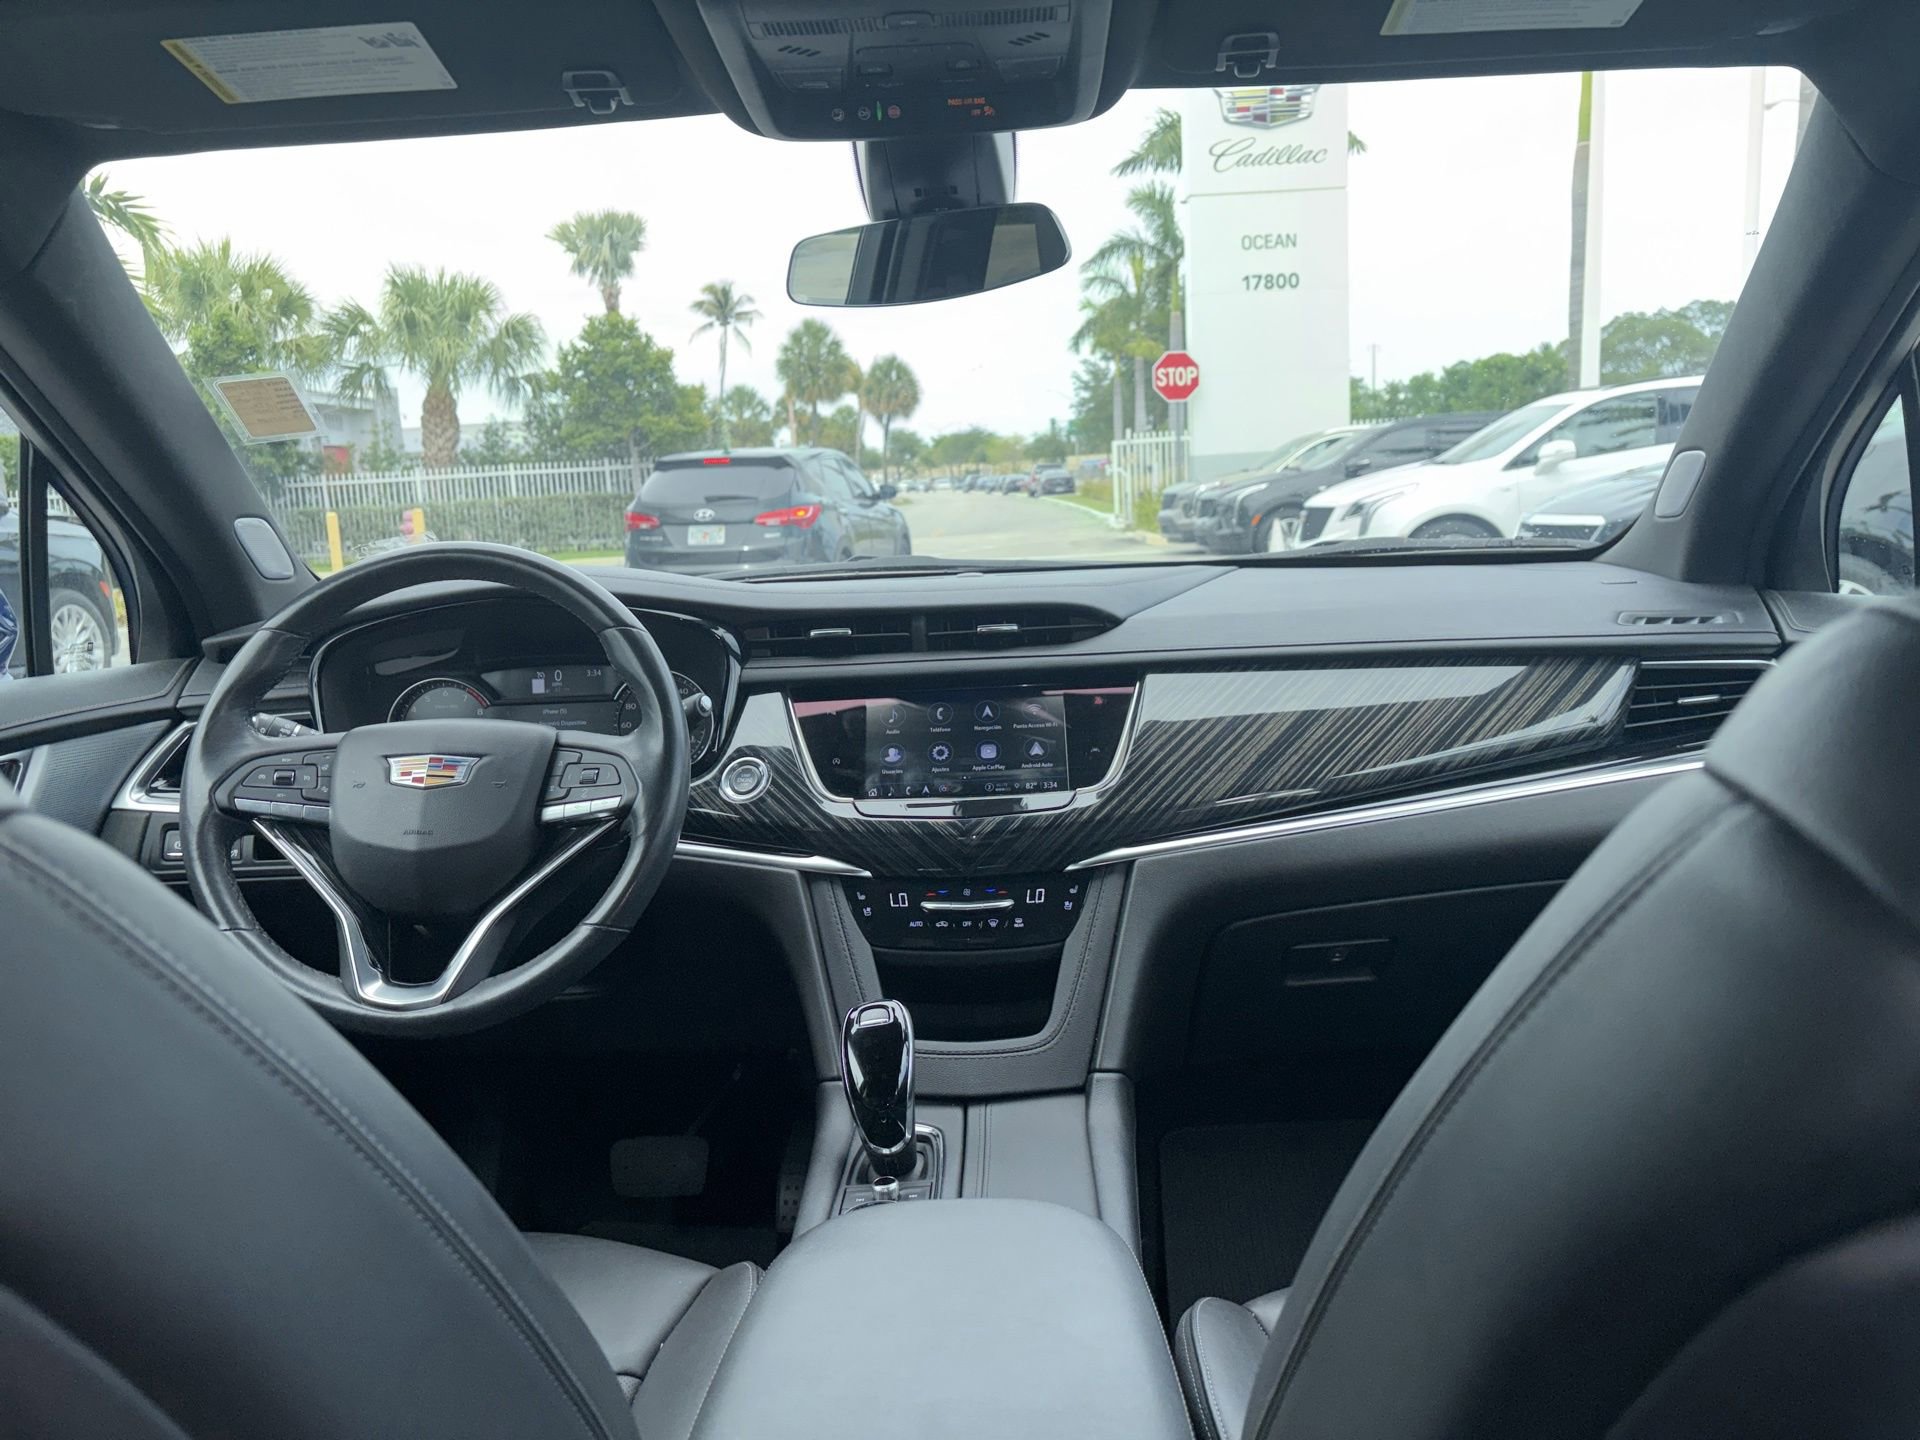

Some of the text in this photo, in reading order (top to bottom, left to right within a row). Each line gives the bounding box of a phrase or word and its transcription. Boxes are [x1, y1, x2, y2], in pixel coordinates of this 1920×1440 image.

[1208, 136, 1328, 173] Cadillac
[1241, 233, 1298, 250] OCEAN
[1241, 273, 1300, 291] 17800
[1156, 366, 1198, 387] STOP
[554, 669, 563, 682] 0
[586, 669, 602, 678] 3:34
[463, 694, 468, 702] 7
[1043, 781, 1058, 789] 3:34
